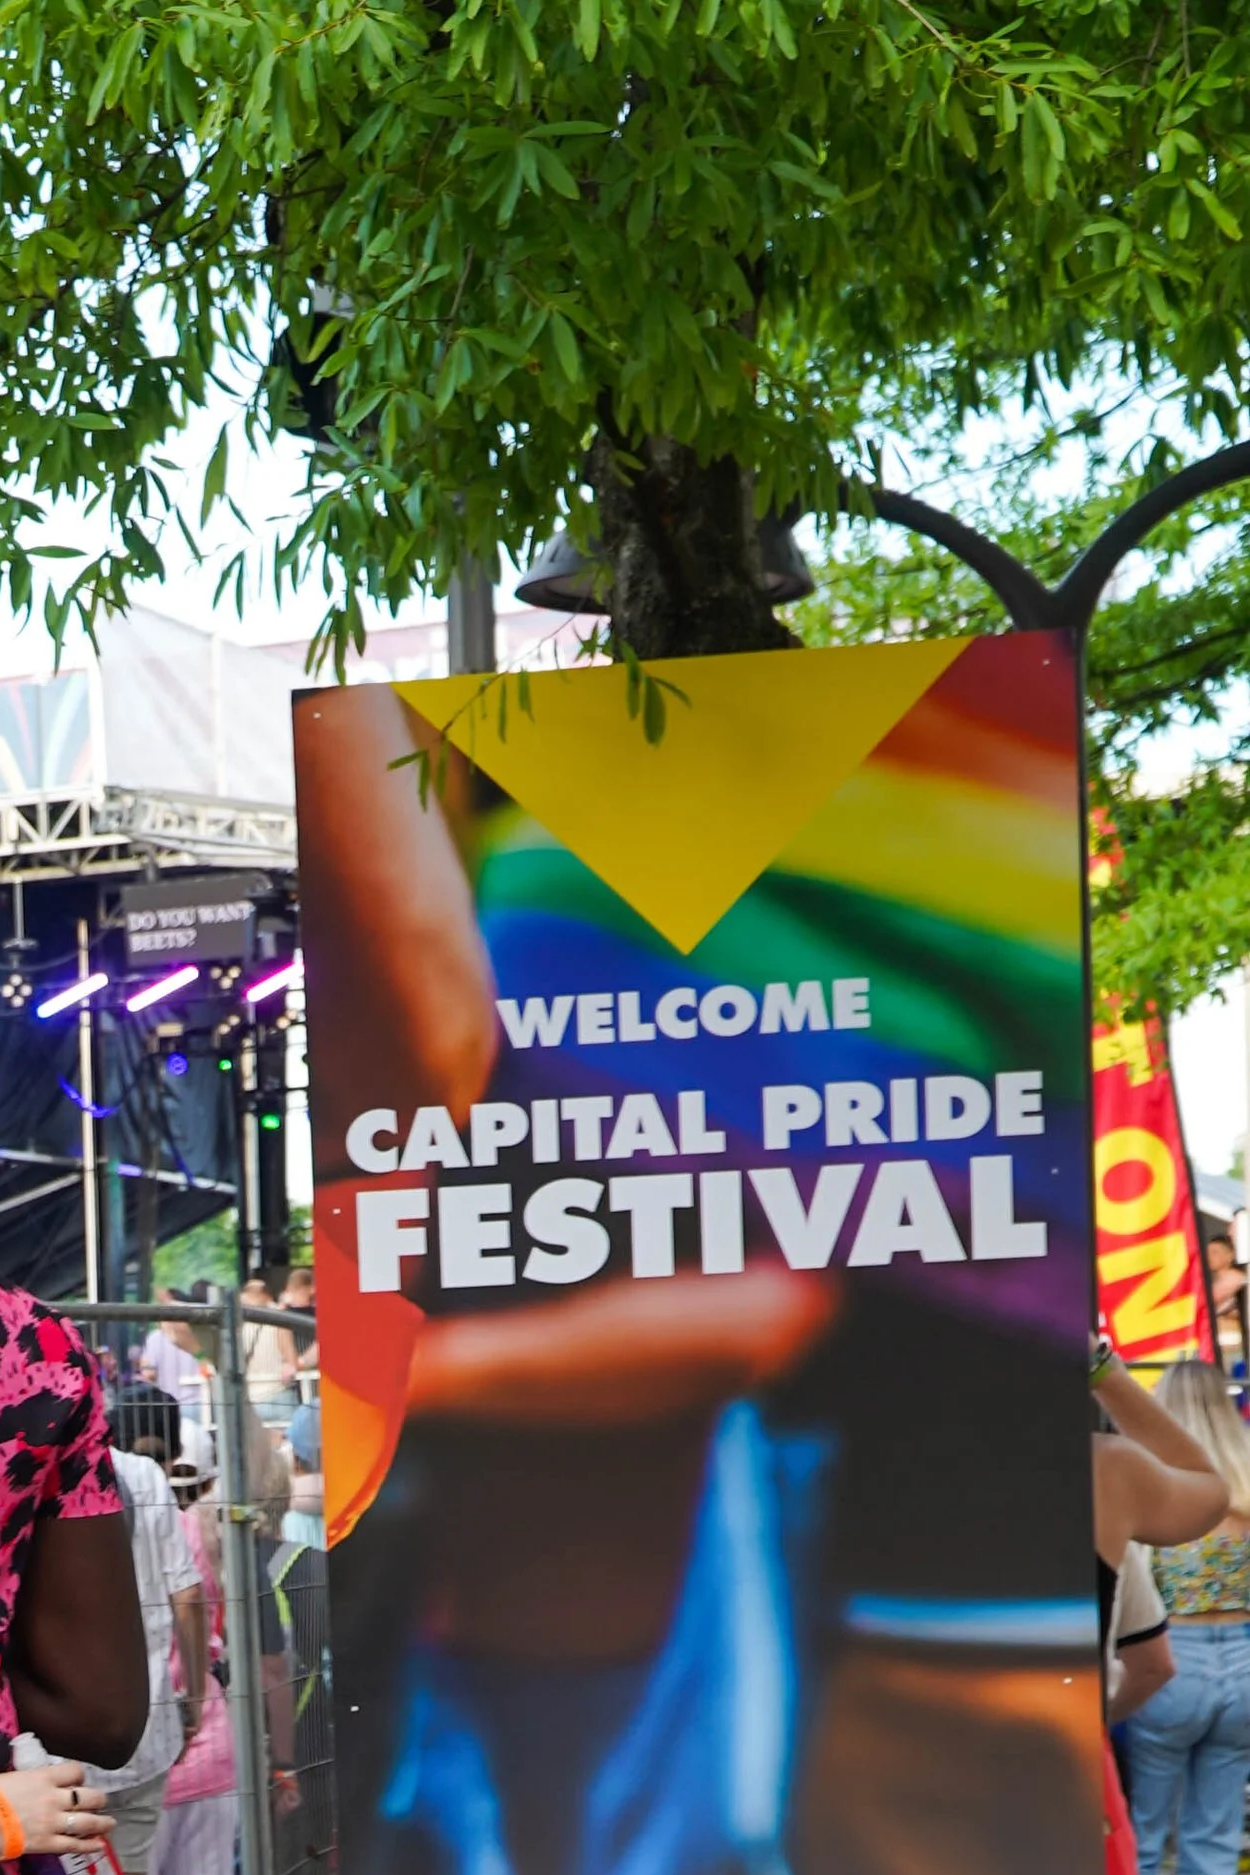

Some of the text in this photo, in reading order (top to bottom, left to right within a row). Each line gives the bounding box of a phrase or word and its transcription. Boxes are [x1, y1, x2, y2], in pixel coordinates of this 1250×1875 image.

[129, 901, 255, 932] DO YOU WANT
[496, 977, 871, 1048] WELCOME
[346, 1070, 1045, 1173] CAPITAL PRIDE
[356, 1155, 1048, 1293] FESTIVAL
